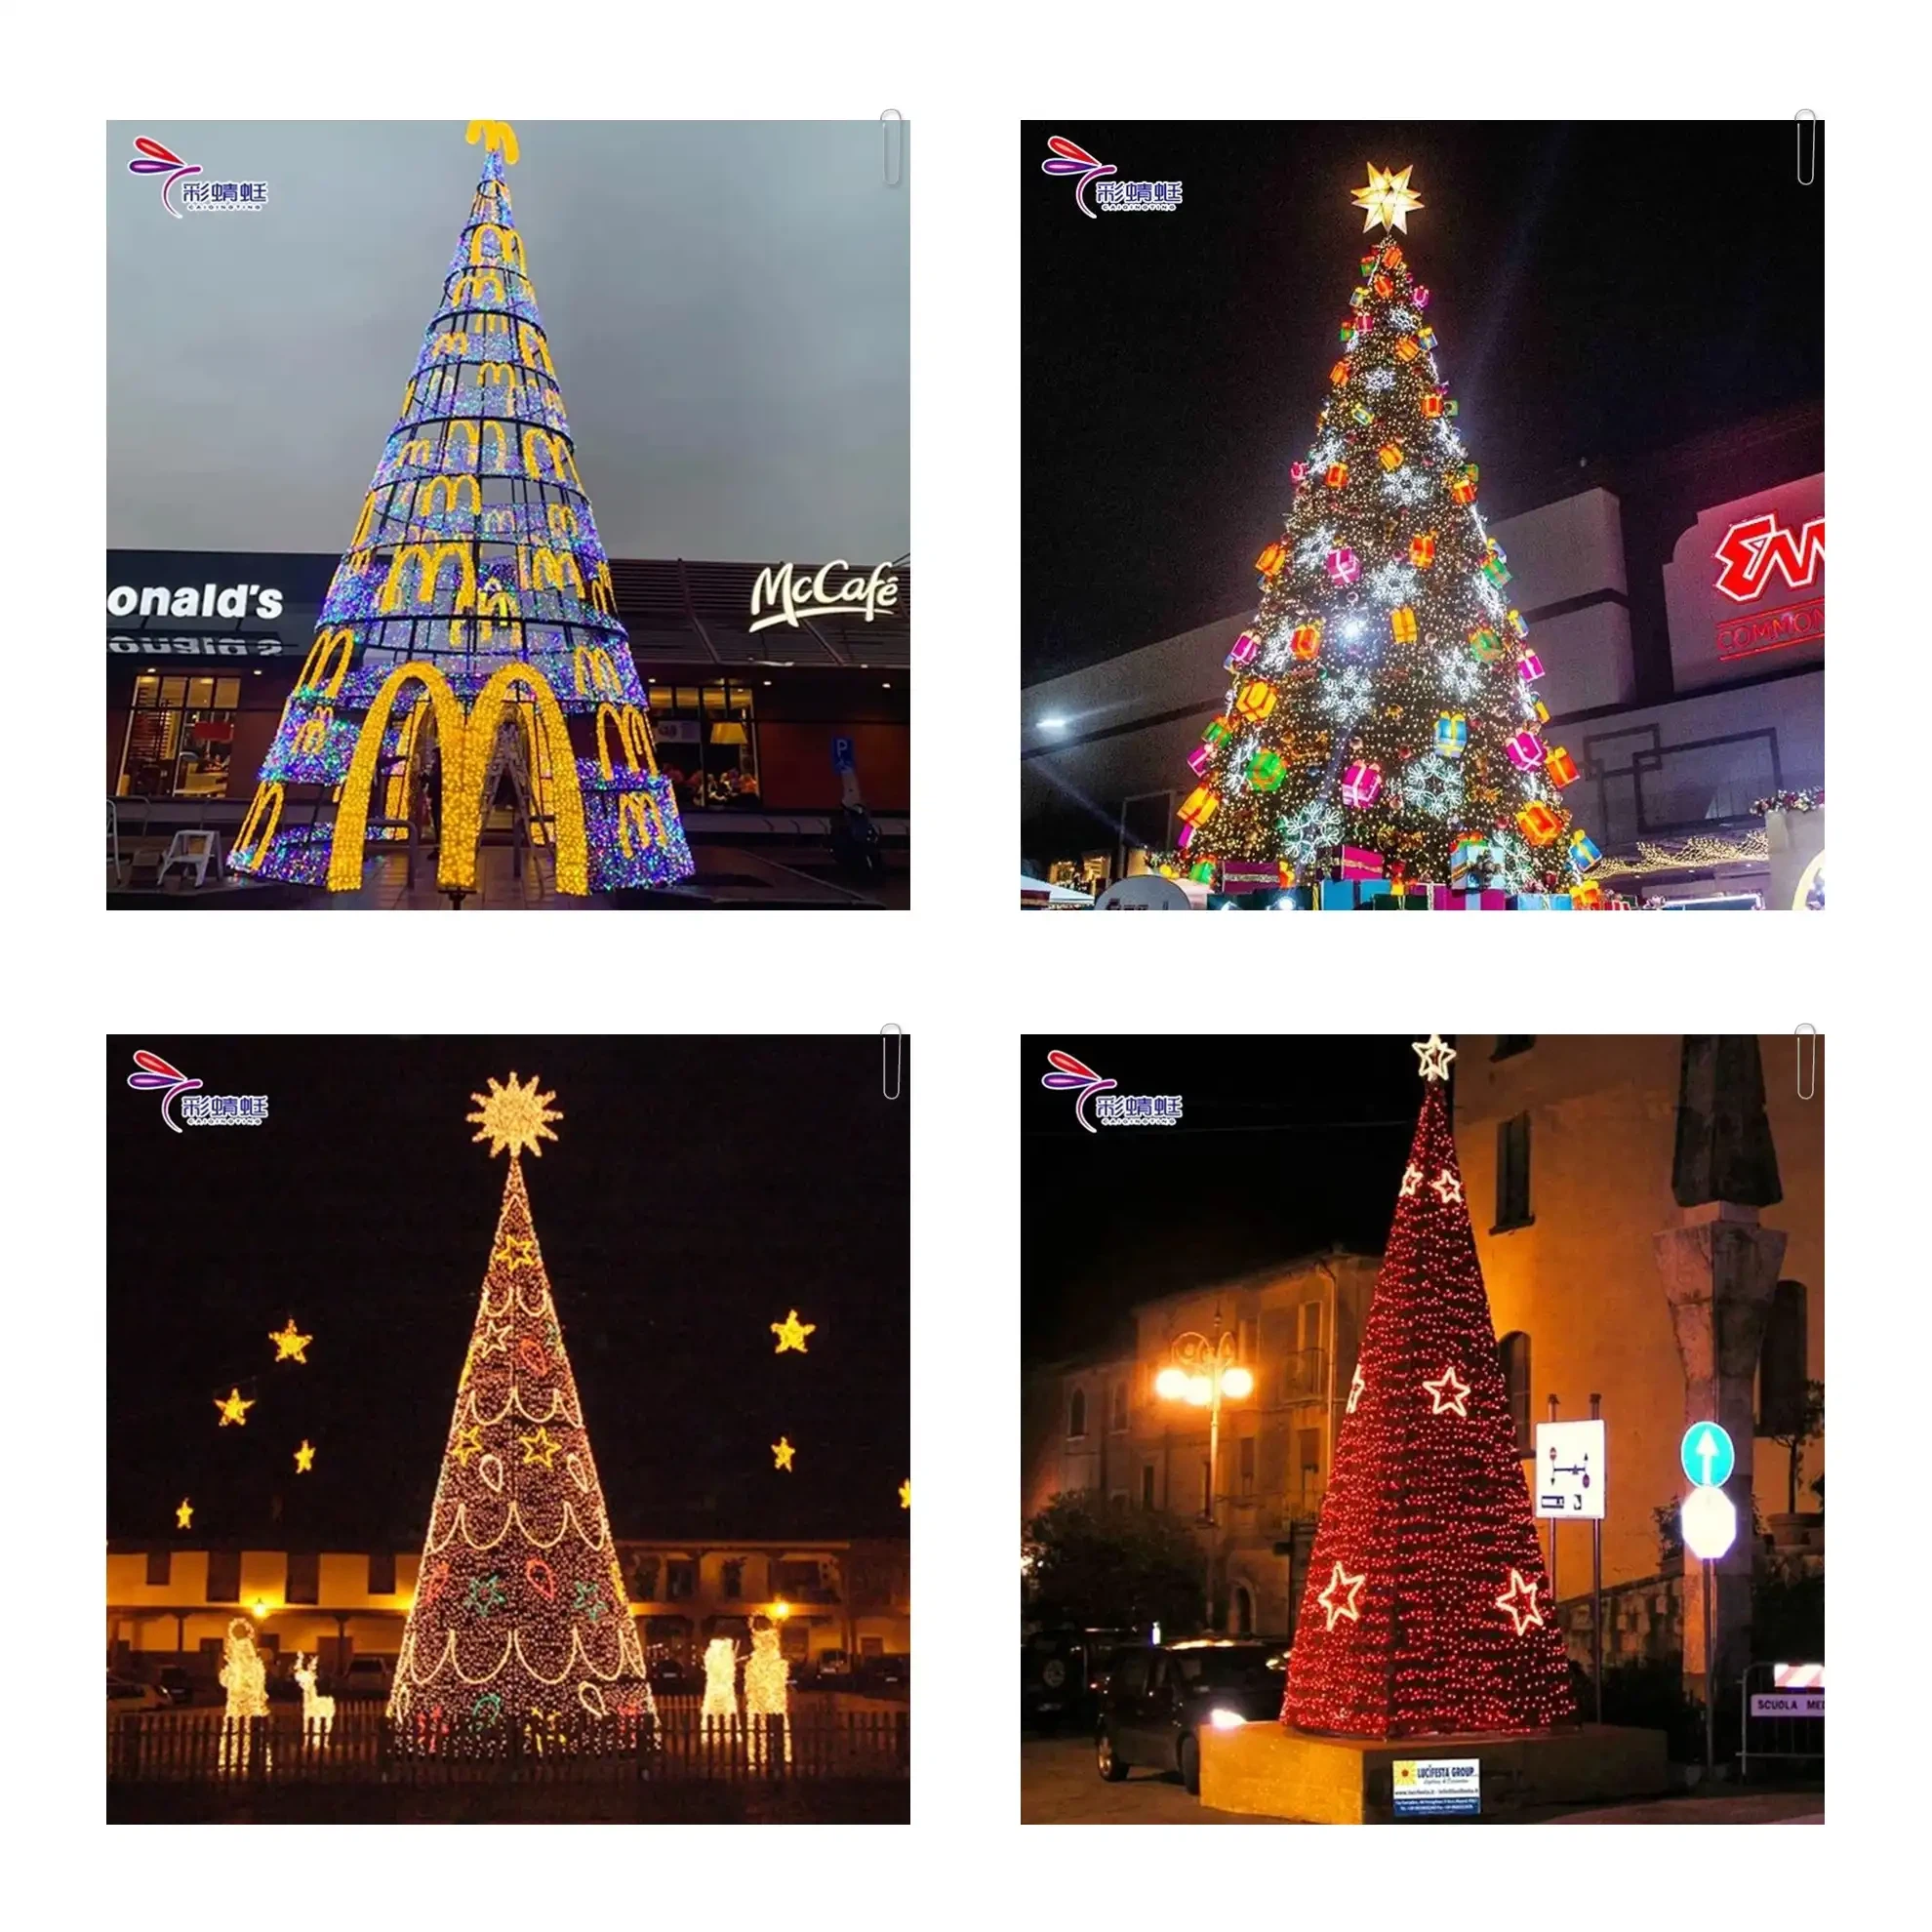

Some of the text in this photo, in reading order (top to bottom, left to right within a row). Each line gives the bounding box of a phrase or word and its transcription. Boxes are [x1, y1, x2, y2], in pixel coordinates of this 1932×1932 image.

[107, 584, 283, 619] onald's
[749, 559, 899, 629] McCafé
[836, 739, 848, 758] P
[1757, 1700, 1798, 1711] SCUOLA
[1451, 1766, 1474, 1777] GROUP
